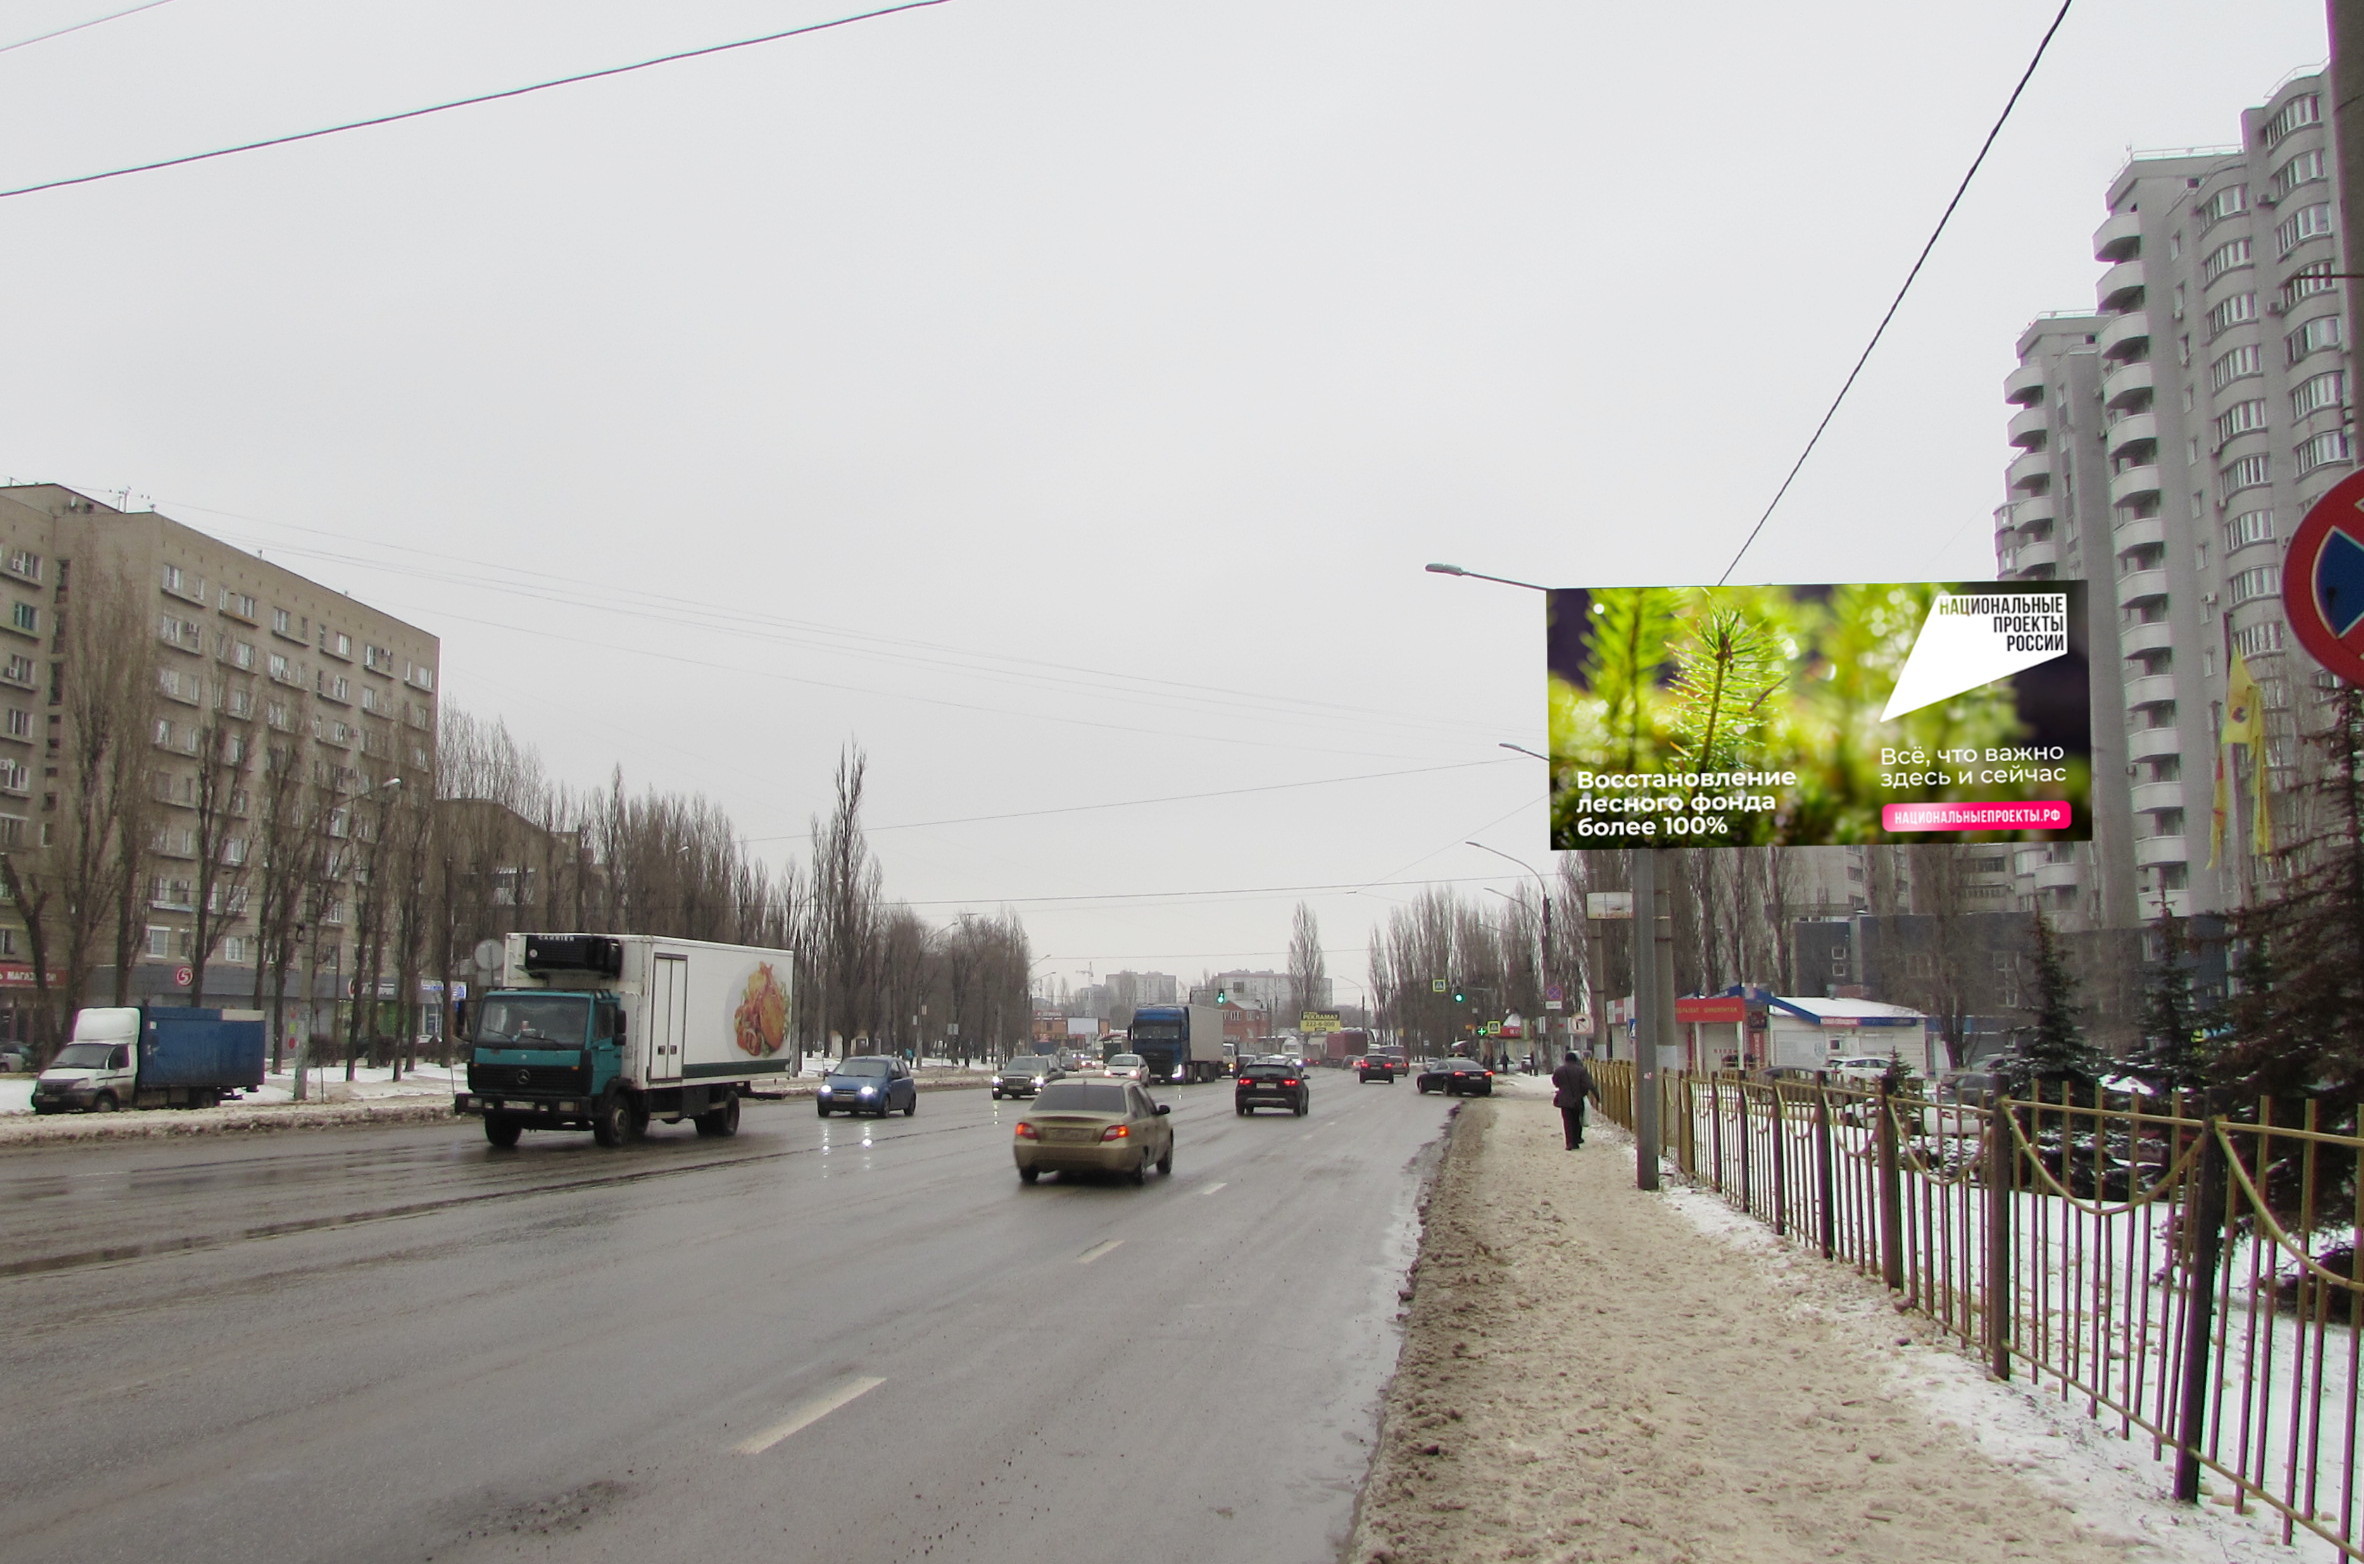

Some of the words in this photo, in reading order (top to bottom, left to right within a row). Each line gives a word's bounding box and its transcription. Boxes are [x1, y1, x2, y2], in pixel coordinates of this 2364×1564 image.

[1940, 596, 2064, 616] НАЦИОНАЛЬНЫЕ
[1993, 615, 2064, 633] ПРОЕКТЫ
[2006, 634, 2064, 652] РОССИИ
[1880, 746, 1931, 767] Всё,
[1937, 748, 1978, 764] что
[1985, 746, 2065, 762] важно
[1577, 771, 1797, 789] Восстановление
[1880, 771, 1951, 789] здесь
[1958, 771, 1973, 785] и
[1980, 765, 2067, 783] сейчас
[1576, 796, 1684, 813] лесного
[1690, 792, 1776, 814] фонда
[1577, 817, 1657, 837] более
[1663, 816, 1729, 836] 100%
[1894, 808, 2061, 825] НАЦИОНАЛЬНЫЕПРОЕКТЫ.РФ
